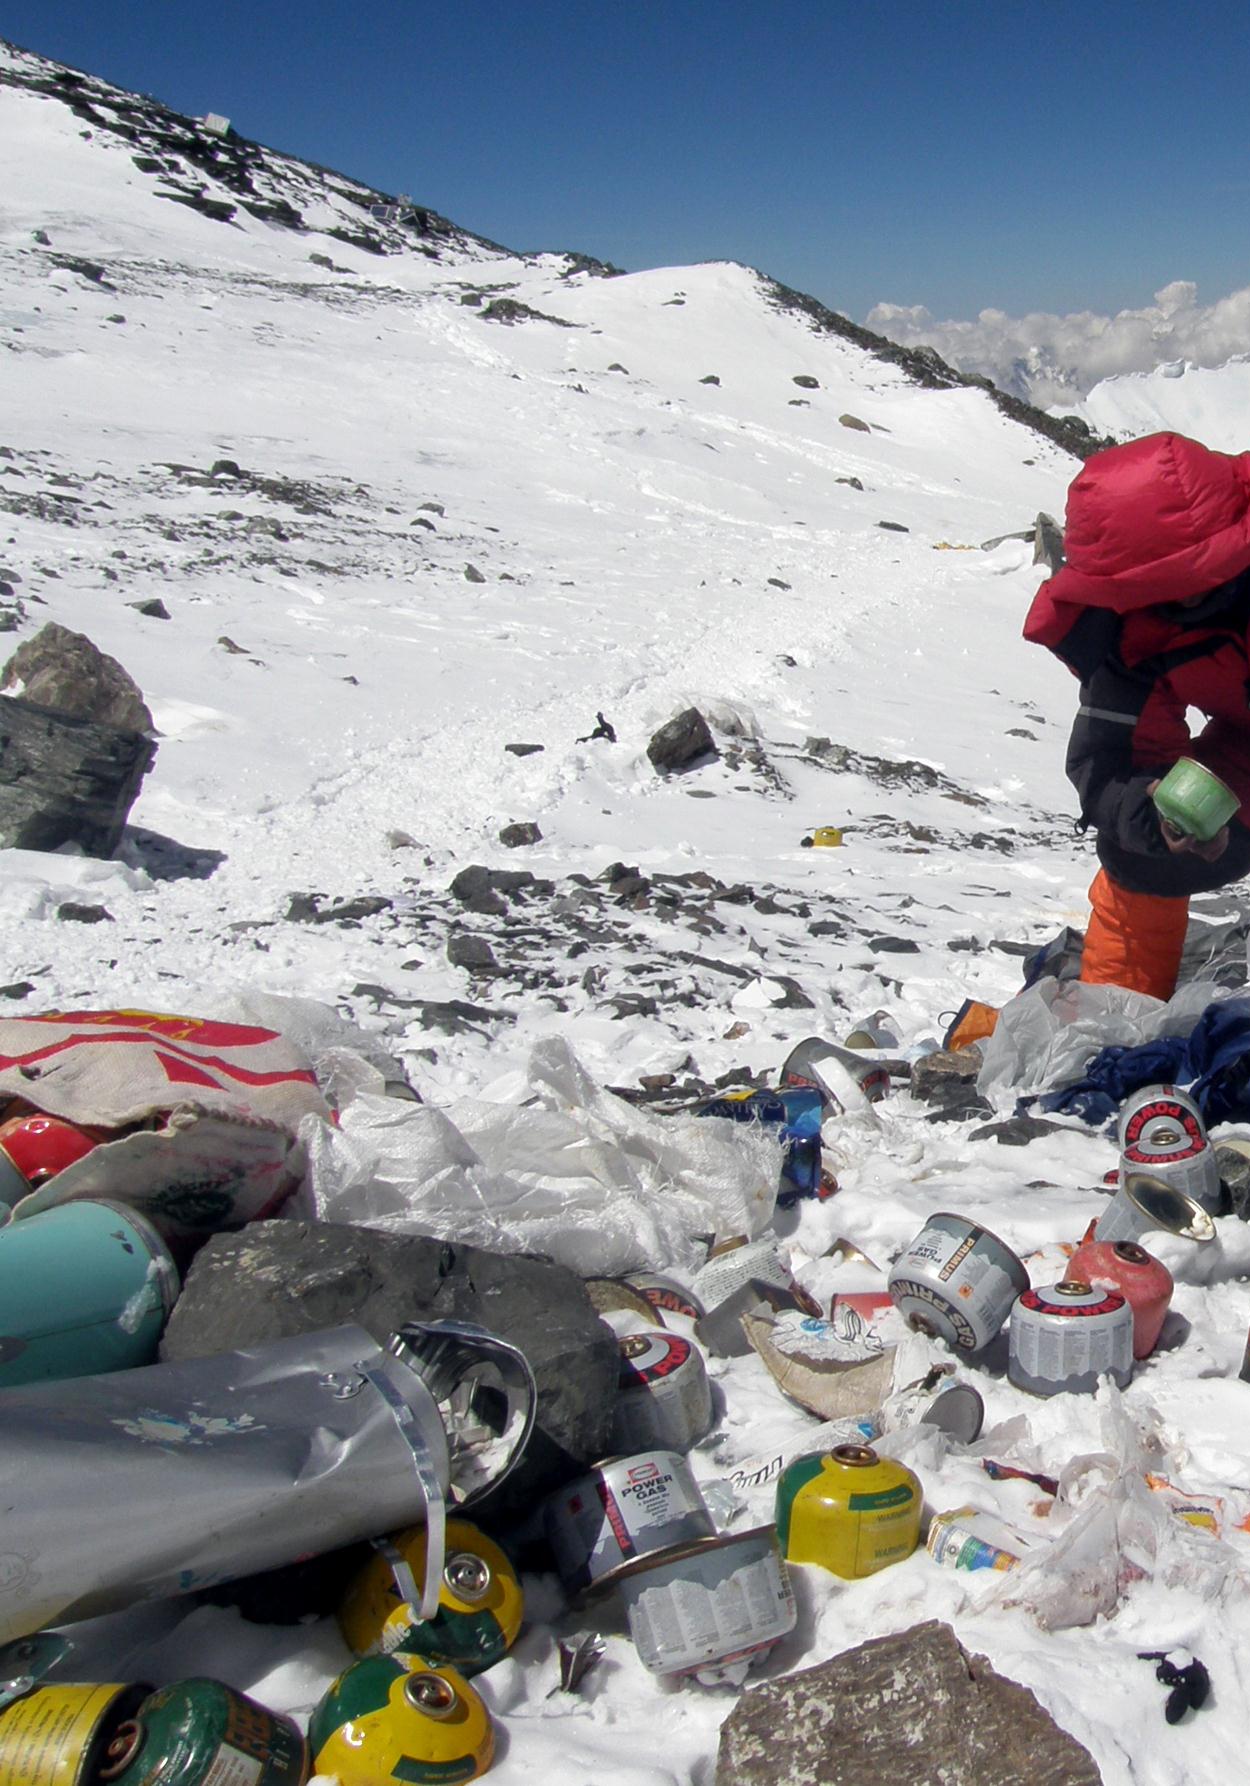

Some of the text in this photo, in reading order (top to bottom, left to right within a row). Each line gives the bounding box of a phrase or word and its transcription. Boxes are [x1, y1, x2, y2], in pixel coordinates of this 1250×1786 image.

[1126, 1101, 1182, 1141] POWER
[940, 1237, 976, 1281] PRIMUS
[956, 1312, 976, 1348] GAS
[621, 1474, 673, 1498] POWER
[636, 1485, 668, 1501] GAS
